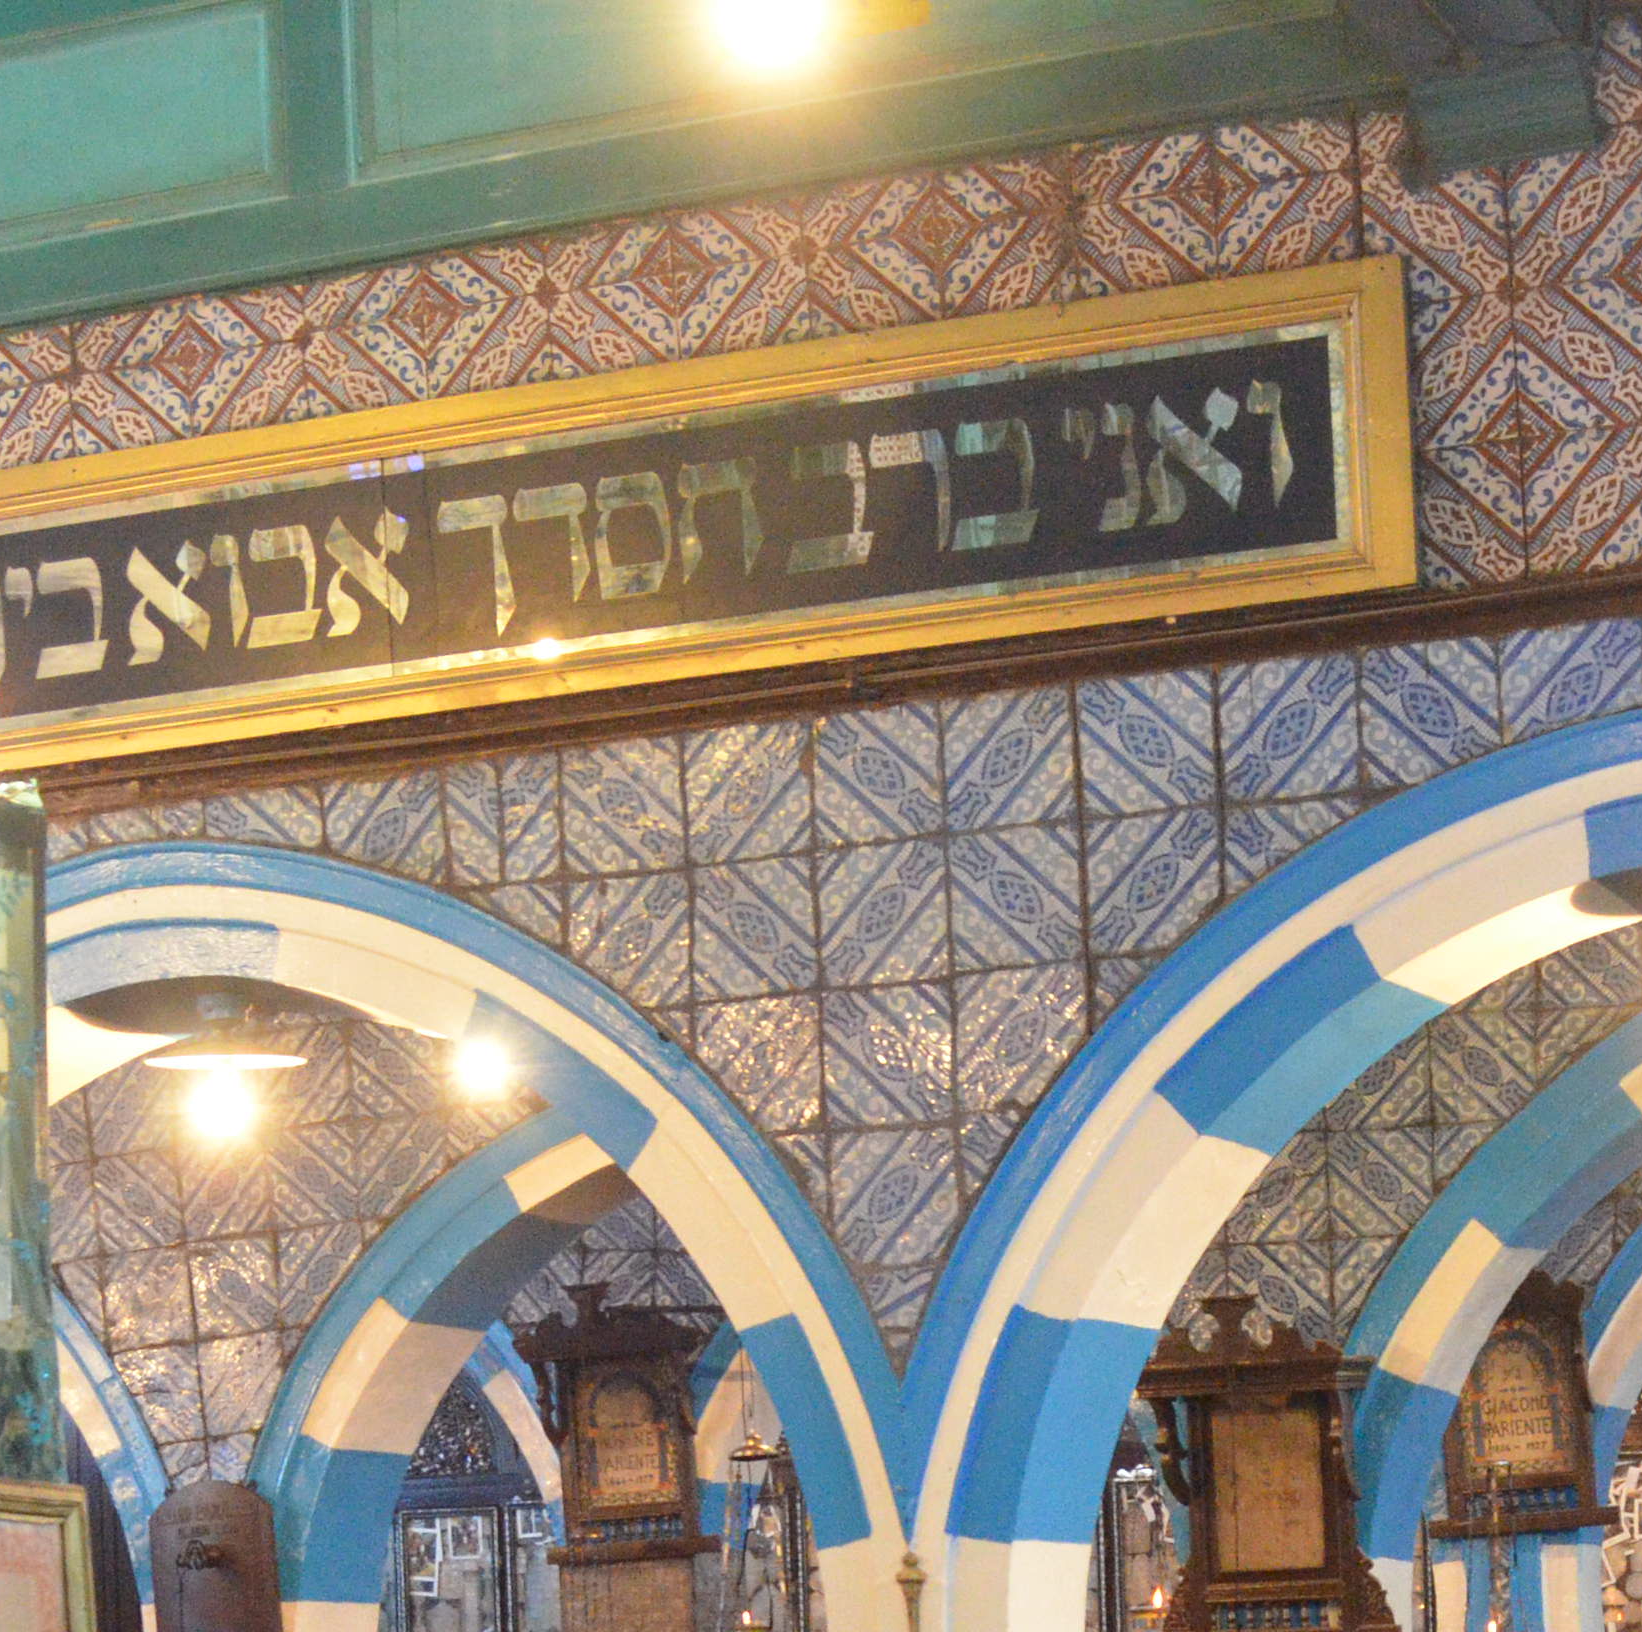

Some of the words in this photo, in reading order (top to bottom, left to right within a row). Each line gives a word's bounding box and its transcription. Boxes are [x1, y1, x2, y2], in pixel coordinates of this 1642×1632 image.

[788, 417, 1040, 574] ברב
[1065, 379, 1294, 532] ואני
[125, 506, 410, 667] אבוא
[438, 457, 764, 638] חסדך
